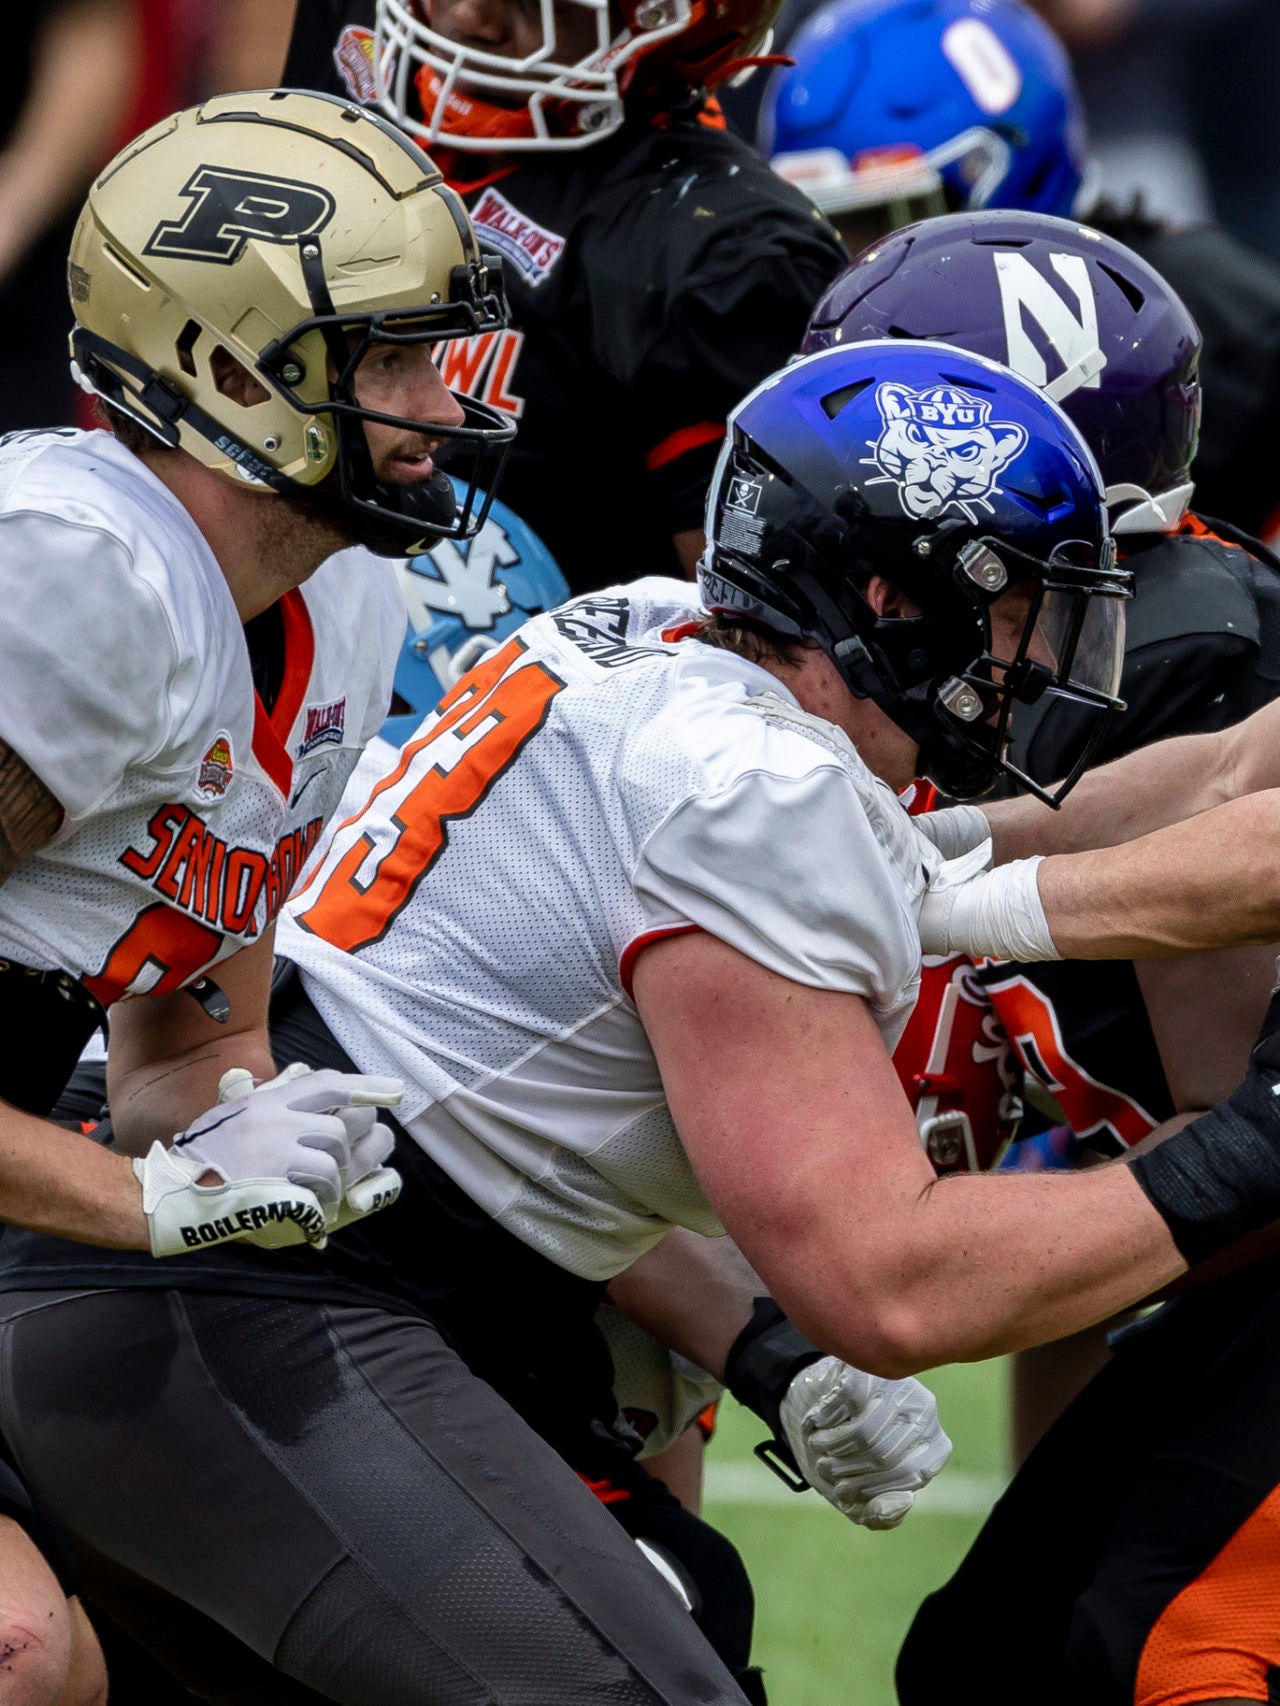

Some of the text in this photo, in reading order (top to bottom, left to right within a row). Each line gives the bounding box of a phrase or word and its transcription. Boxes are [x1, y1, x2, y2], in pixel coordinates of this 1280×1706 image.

[141, 163, 336, 266] P
[993, 252, 1101, 388] N
[431, 328, 524, 418] WL
[920, 403, 975, 425] BYU
[118, 803, 269, 937] SENIO
